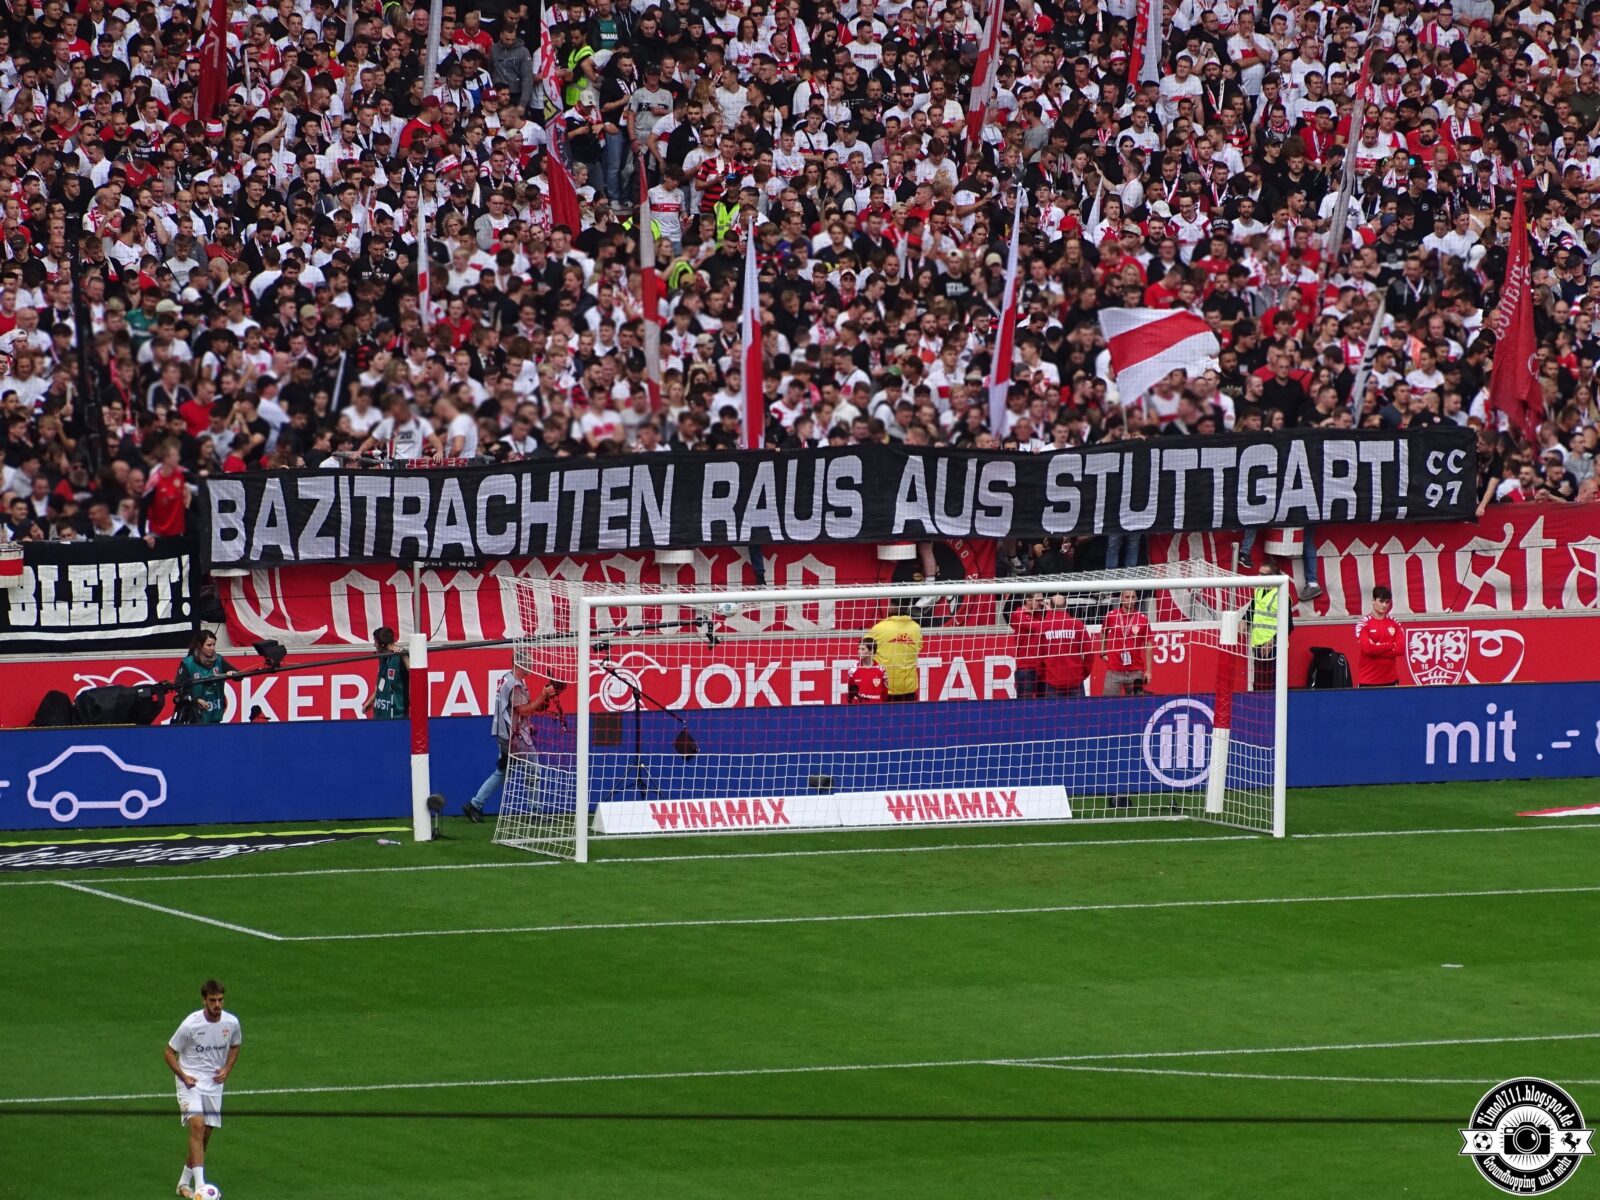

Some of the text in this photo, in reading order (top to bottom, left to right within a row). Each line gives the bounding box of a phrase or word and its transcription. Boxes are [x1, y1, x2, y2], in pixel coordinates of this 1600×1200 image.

[1426, 449, 1467, 475] CC
[209, 438, 1409, 562] BAZITRACHTEN RAUS AUS STUTTGART!
[1425, 481, 1462, 508] 97
[8, 554, 191, 626] BLEIBT!
[1153, 633, 1186, 664] 35
[917, 655, 1017, 702] TAR
[1425, 703, 1517, 764] mit
[650, 798, 791, 829] WINAMAX
[885, 790, 1023, 822] WINAMAX
